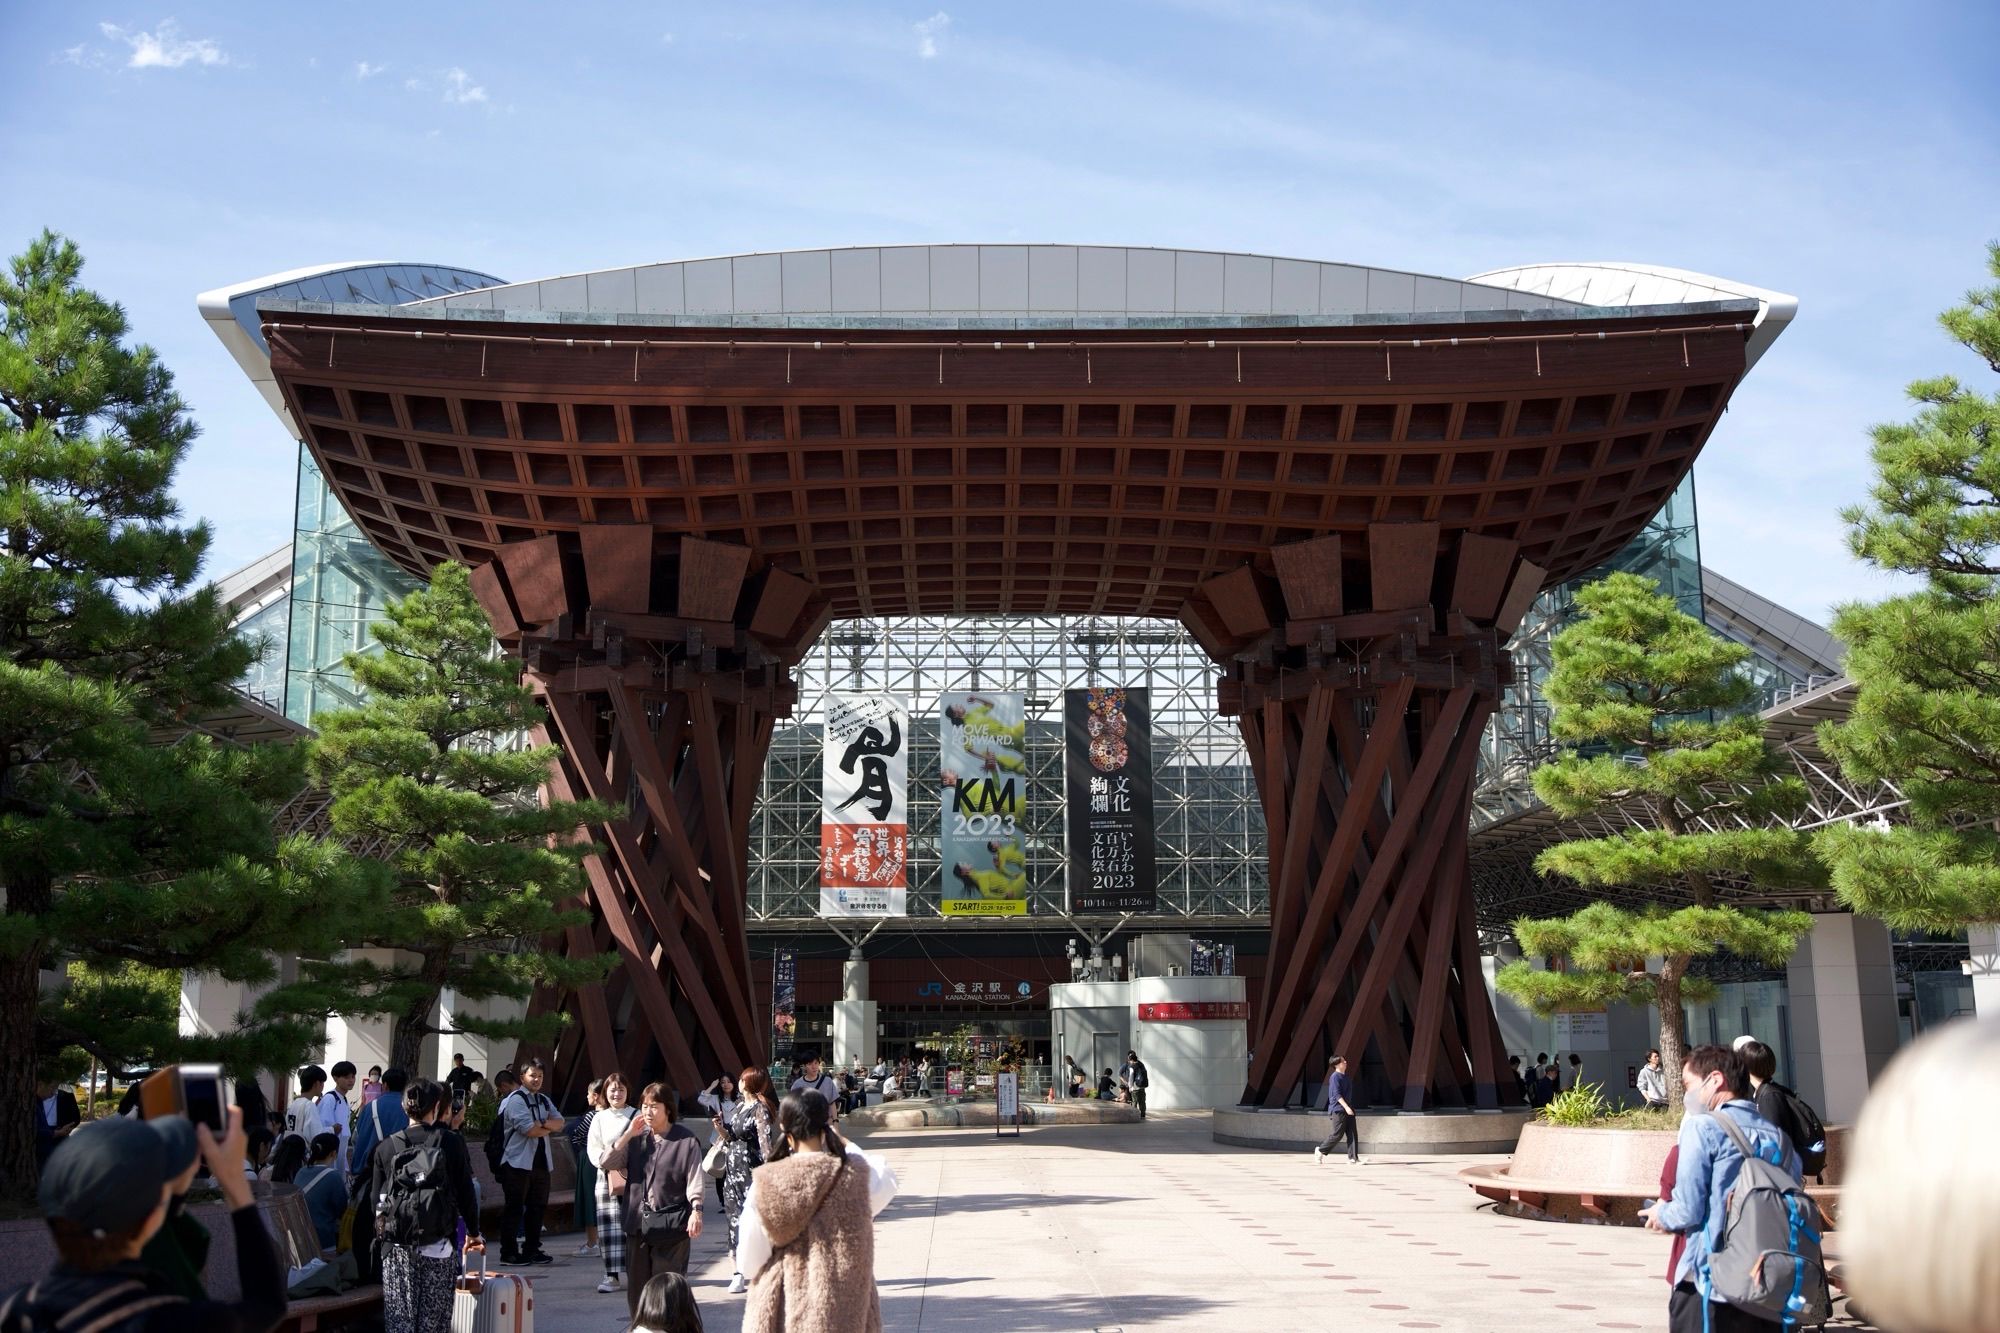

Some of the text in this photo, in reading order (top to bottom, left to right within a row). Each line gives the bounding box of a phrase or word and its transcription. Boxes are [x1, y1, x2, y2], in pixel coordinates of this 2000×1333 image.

[952, 724, 989, 735] MOVE
[952, 735, 1015, 746] FORWARD.
[952, 777, 1016, 813] KM
[1090, 776, 1109, 813] 絢爛
[1112, 775, 1131, 812] 文化
[952, 814, 1016, 836] 2023
[875, 827, 891, 858] 世界
[1090, 832, 1105, 873] 文化祭
[1105, 831, 1120, 873] 百万石
[1120, 832, 1135, 873] いしかわ
[1093, 874, 1135, 889] 2023
[952, 902, 980, 911] START!
[918, 982, 943, 996] JR
[954, 982, 1001, 993] 金沢駅
